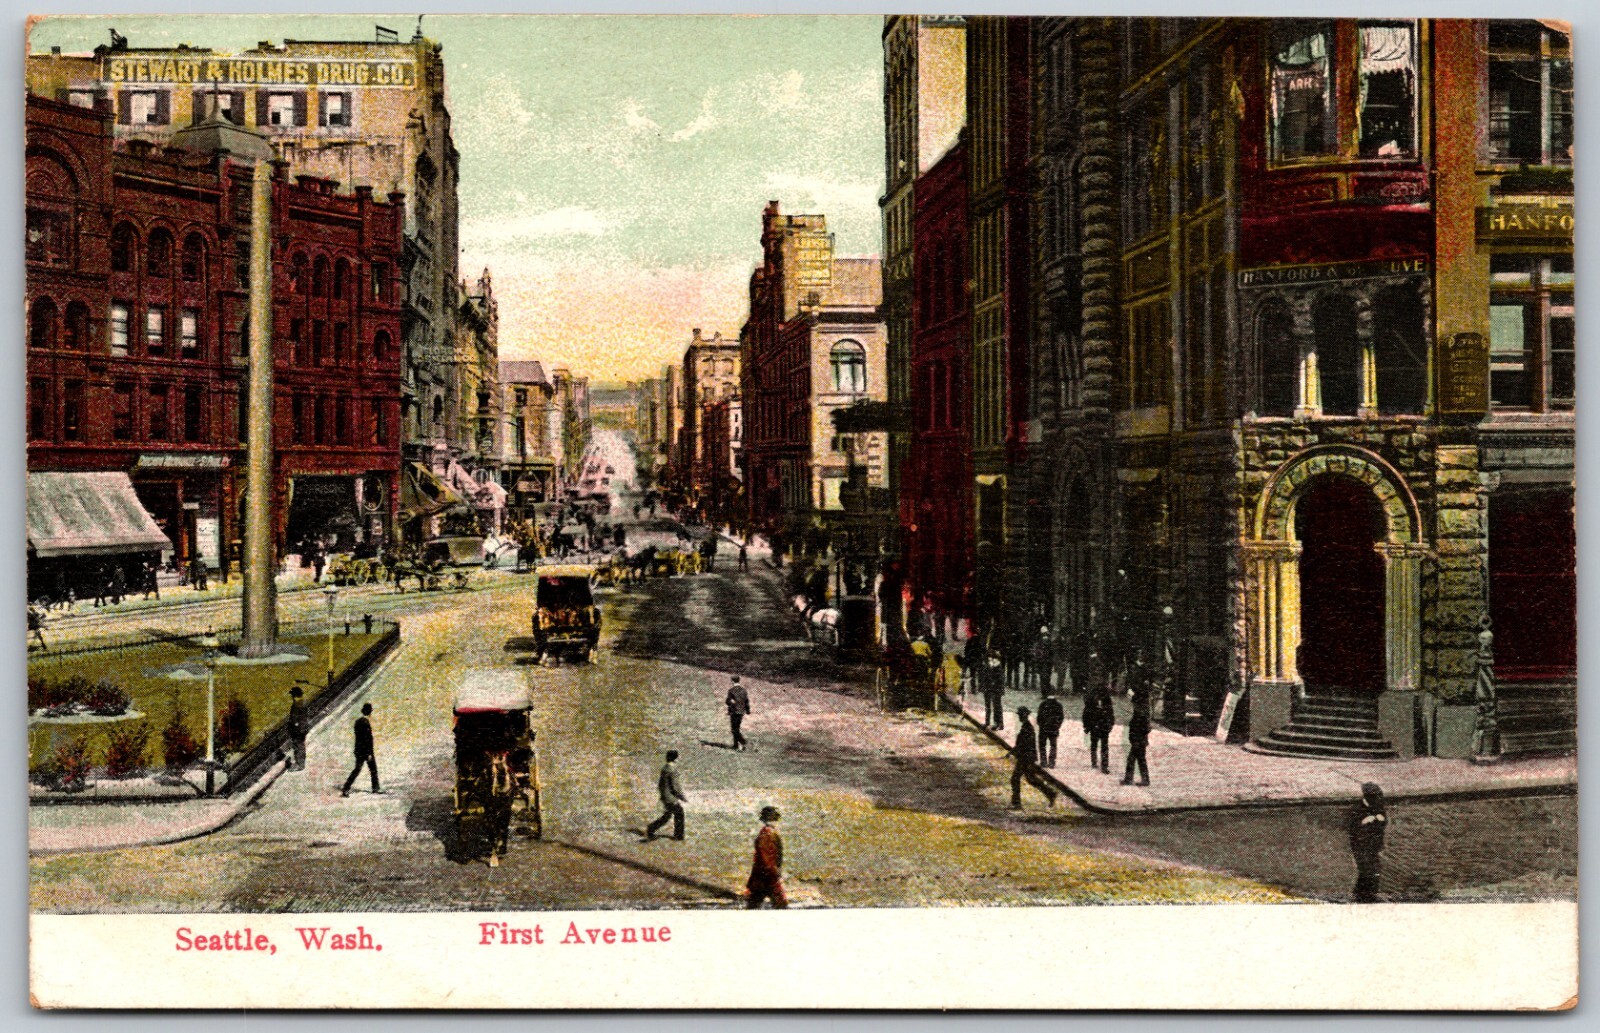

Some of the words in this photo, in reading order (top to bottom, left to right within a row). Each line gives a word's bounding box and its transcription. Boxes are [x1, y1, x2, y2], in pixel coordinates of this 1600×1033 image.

[110, 60, 200, 82] STEWART
[206, 61, 224, 81] &
[229, 61, 309, 83] HOLMES
[317, 63, 370, 84] DRUG
[1243, 266, 1321, 284] HANFORD
